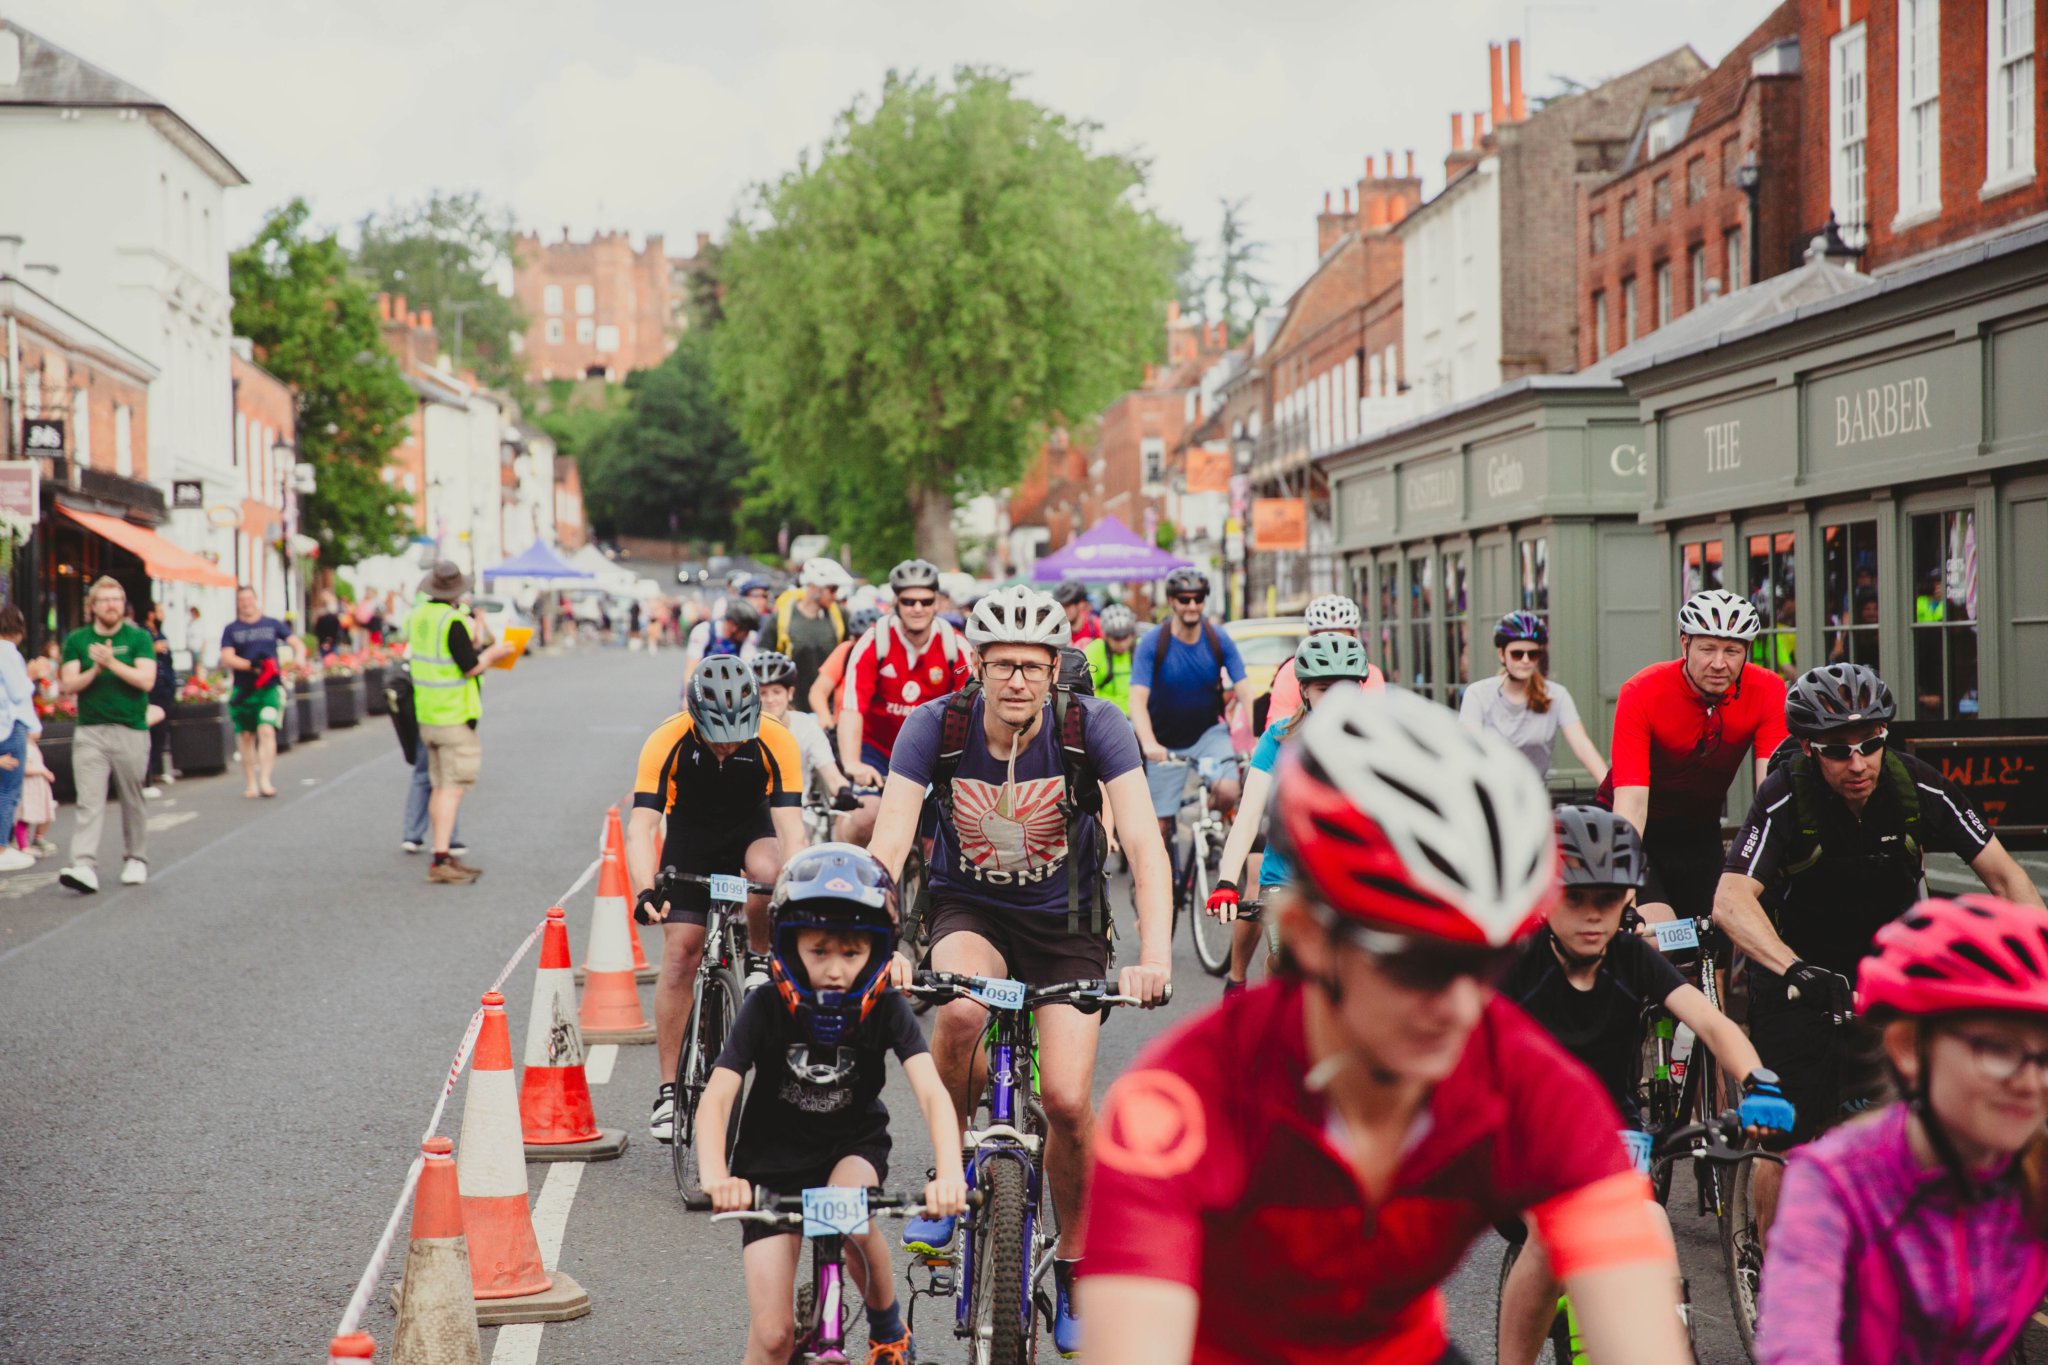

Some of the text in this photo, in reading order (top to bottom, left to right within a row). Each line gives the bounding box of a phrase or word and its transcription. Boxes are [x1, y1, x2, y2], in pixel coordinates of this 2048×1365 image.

[1704, 376, 1932, 473] THE BARBER
[1488, 453, 1524, 499] Gelato
[715, 881, 743, 895] 1099
[1661, 928, 1693, 943] 1085
[810, 1200, 860, 1221] 1094
